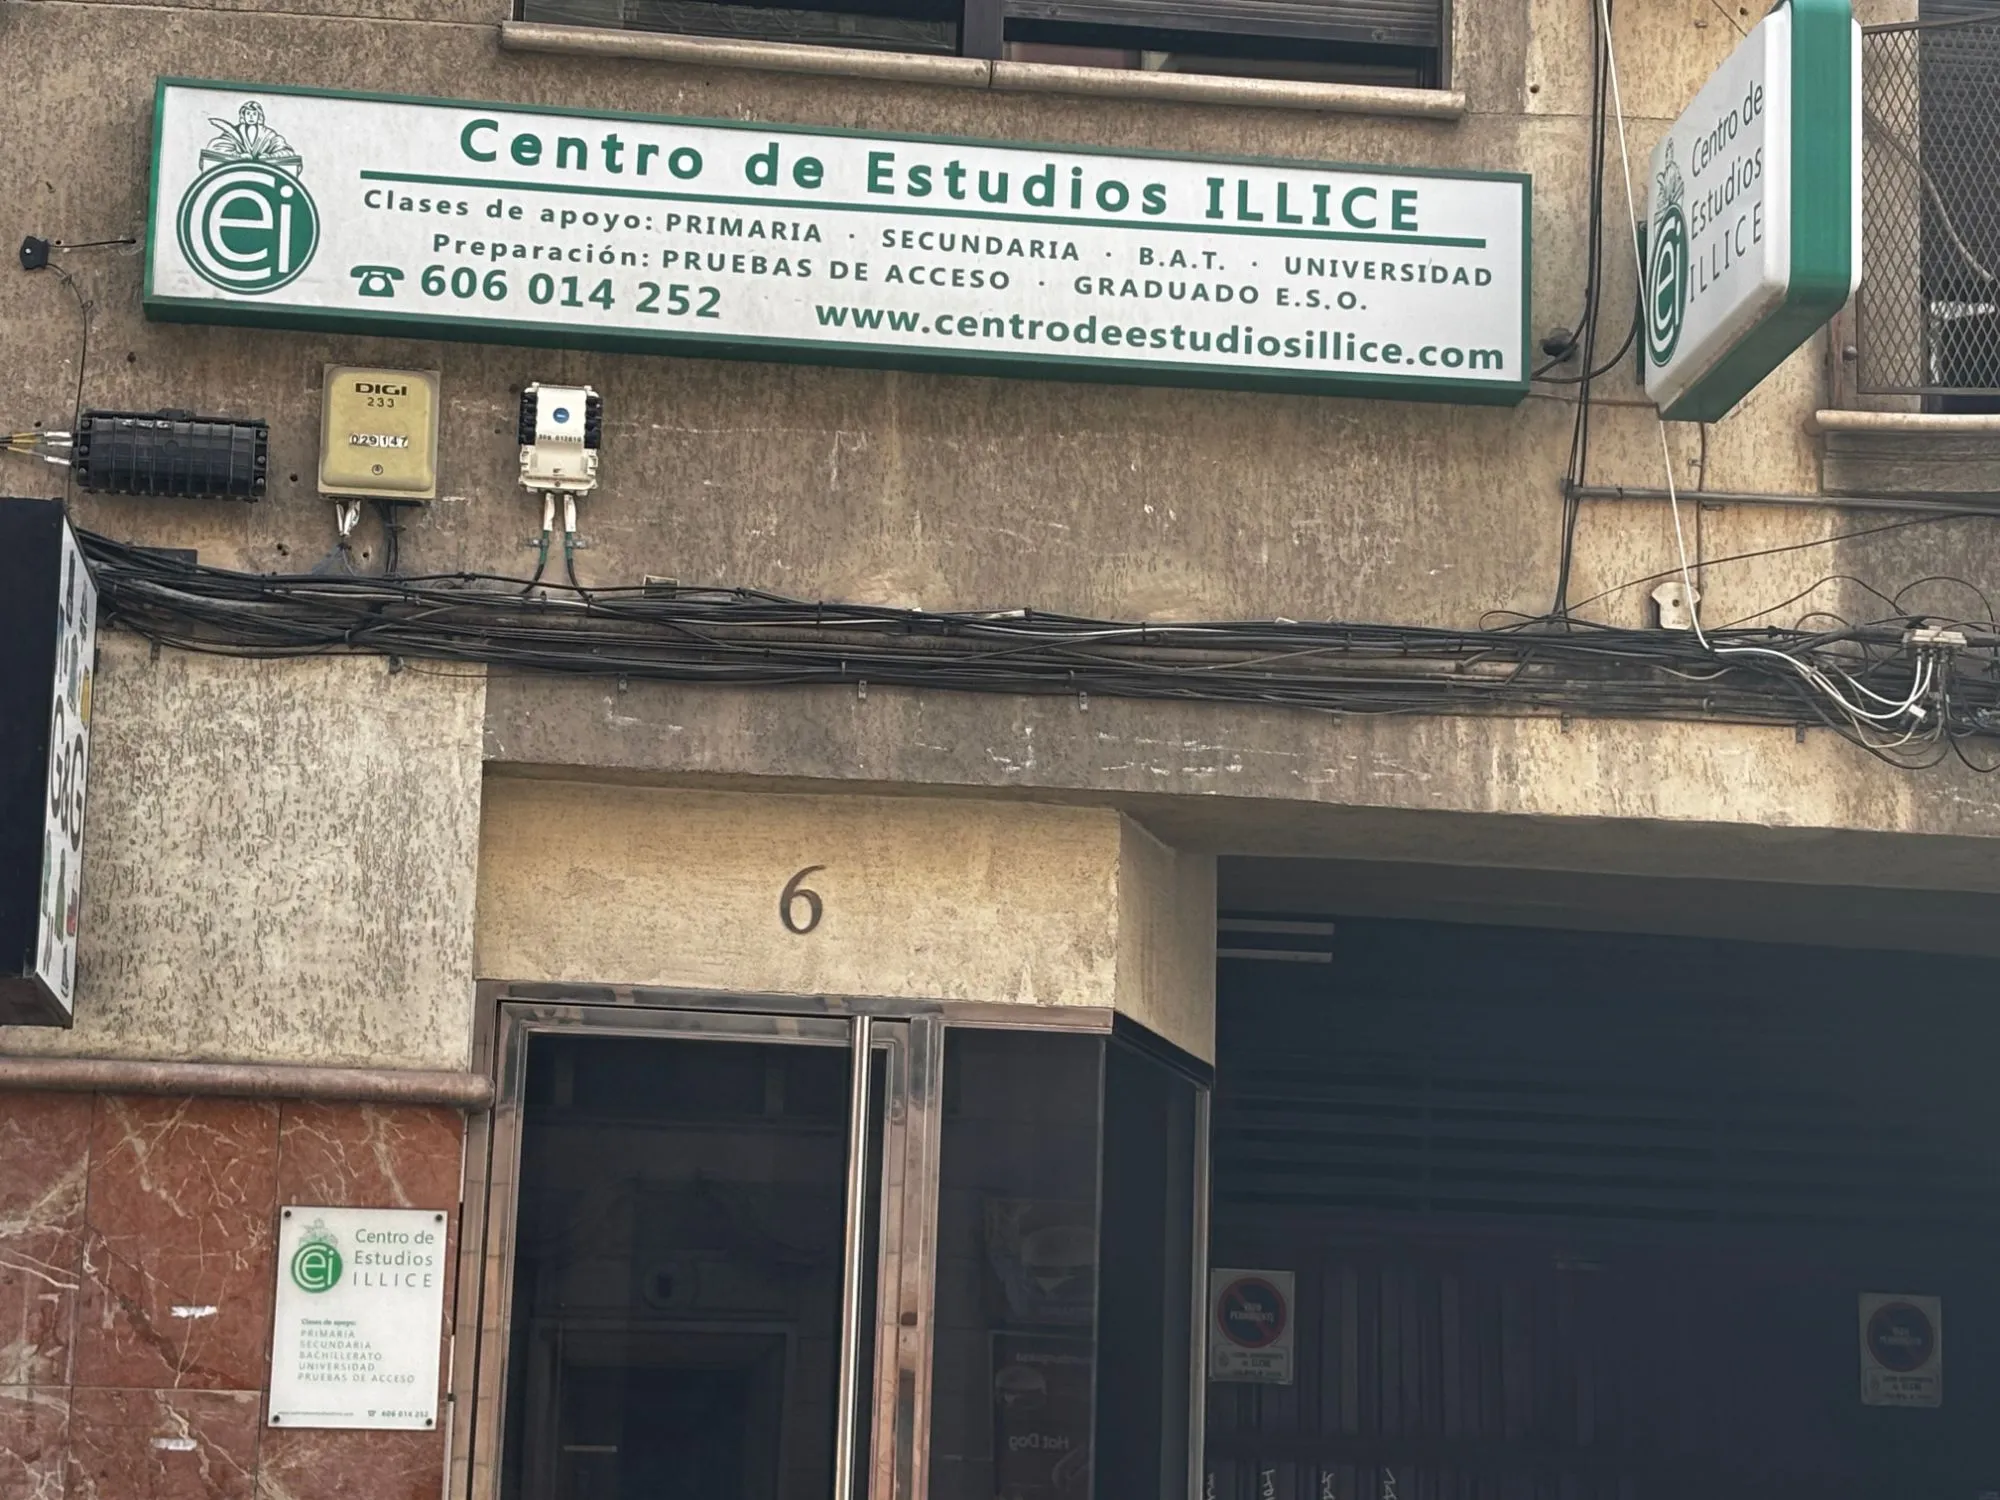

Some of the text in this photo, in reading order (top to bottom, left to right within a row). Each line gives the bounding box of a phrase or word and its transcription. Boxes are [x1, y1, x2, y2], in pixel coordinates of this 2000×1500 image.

[1691, 80, 1763, 178] Centro de
[460, 118, 1419, 233] Centro de Estudios ILLICE
[1691, 146, 1763, 241] Estudios
[364, 189, 1492, 287] Clases de apoyo: PRIMARIA SECUNDARIA B.A.T. UNIVERSIDAD
[1689, 201, 1763, 304] ILLICE
[433, 233, 1368, 311] Preparación: PRUEBAS DE ACCESO GRADUADO E.S.O.
[421, 264, 721, 319] 606 014 252
[815, 305, 1504, 370] www.centrodeestudiosillice.com
[355, 382, 408, 396] DIGI
[367, 396, 395, 409] 233
[351, 434, 409, 447] 029147
[50, 694, 85, 852] G&G
[780, 864, 826, 935] 6
[355, 1228, 434, 1245] Centro de
[354, 1250, 433, 1267] Estudios
[353, 1271, 432, 1288] ILLICE
[300, 1329, 356, 1338] PRIMARIA
[299, 1340, 372, 1349] SECUNDARIA
[298, 1351, 383, 1361] BACHILLERATO
[298, 1362, 376, 1372] UNIVERSIDAD
[297, 1373, 416, 1384] PRUEBAS DE ACCESO
